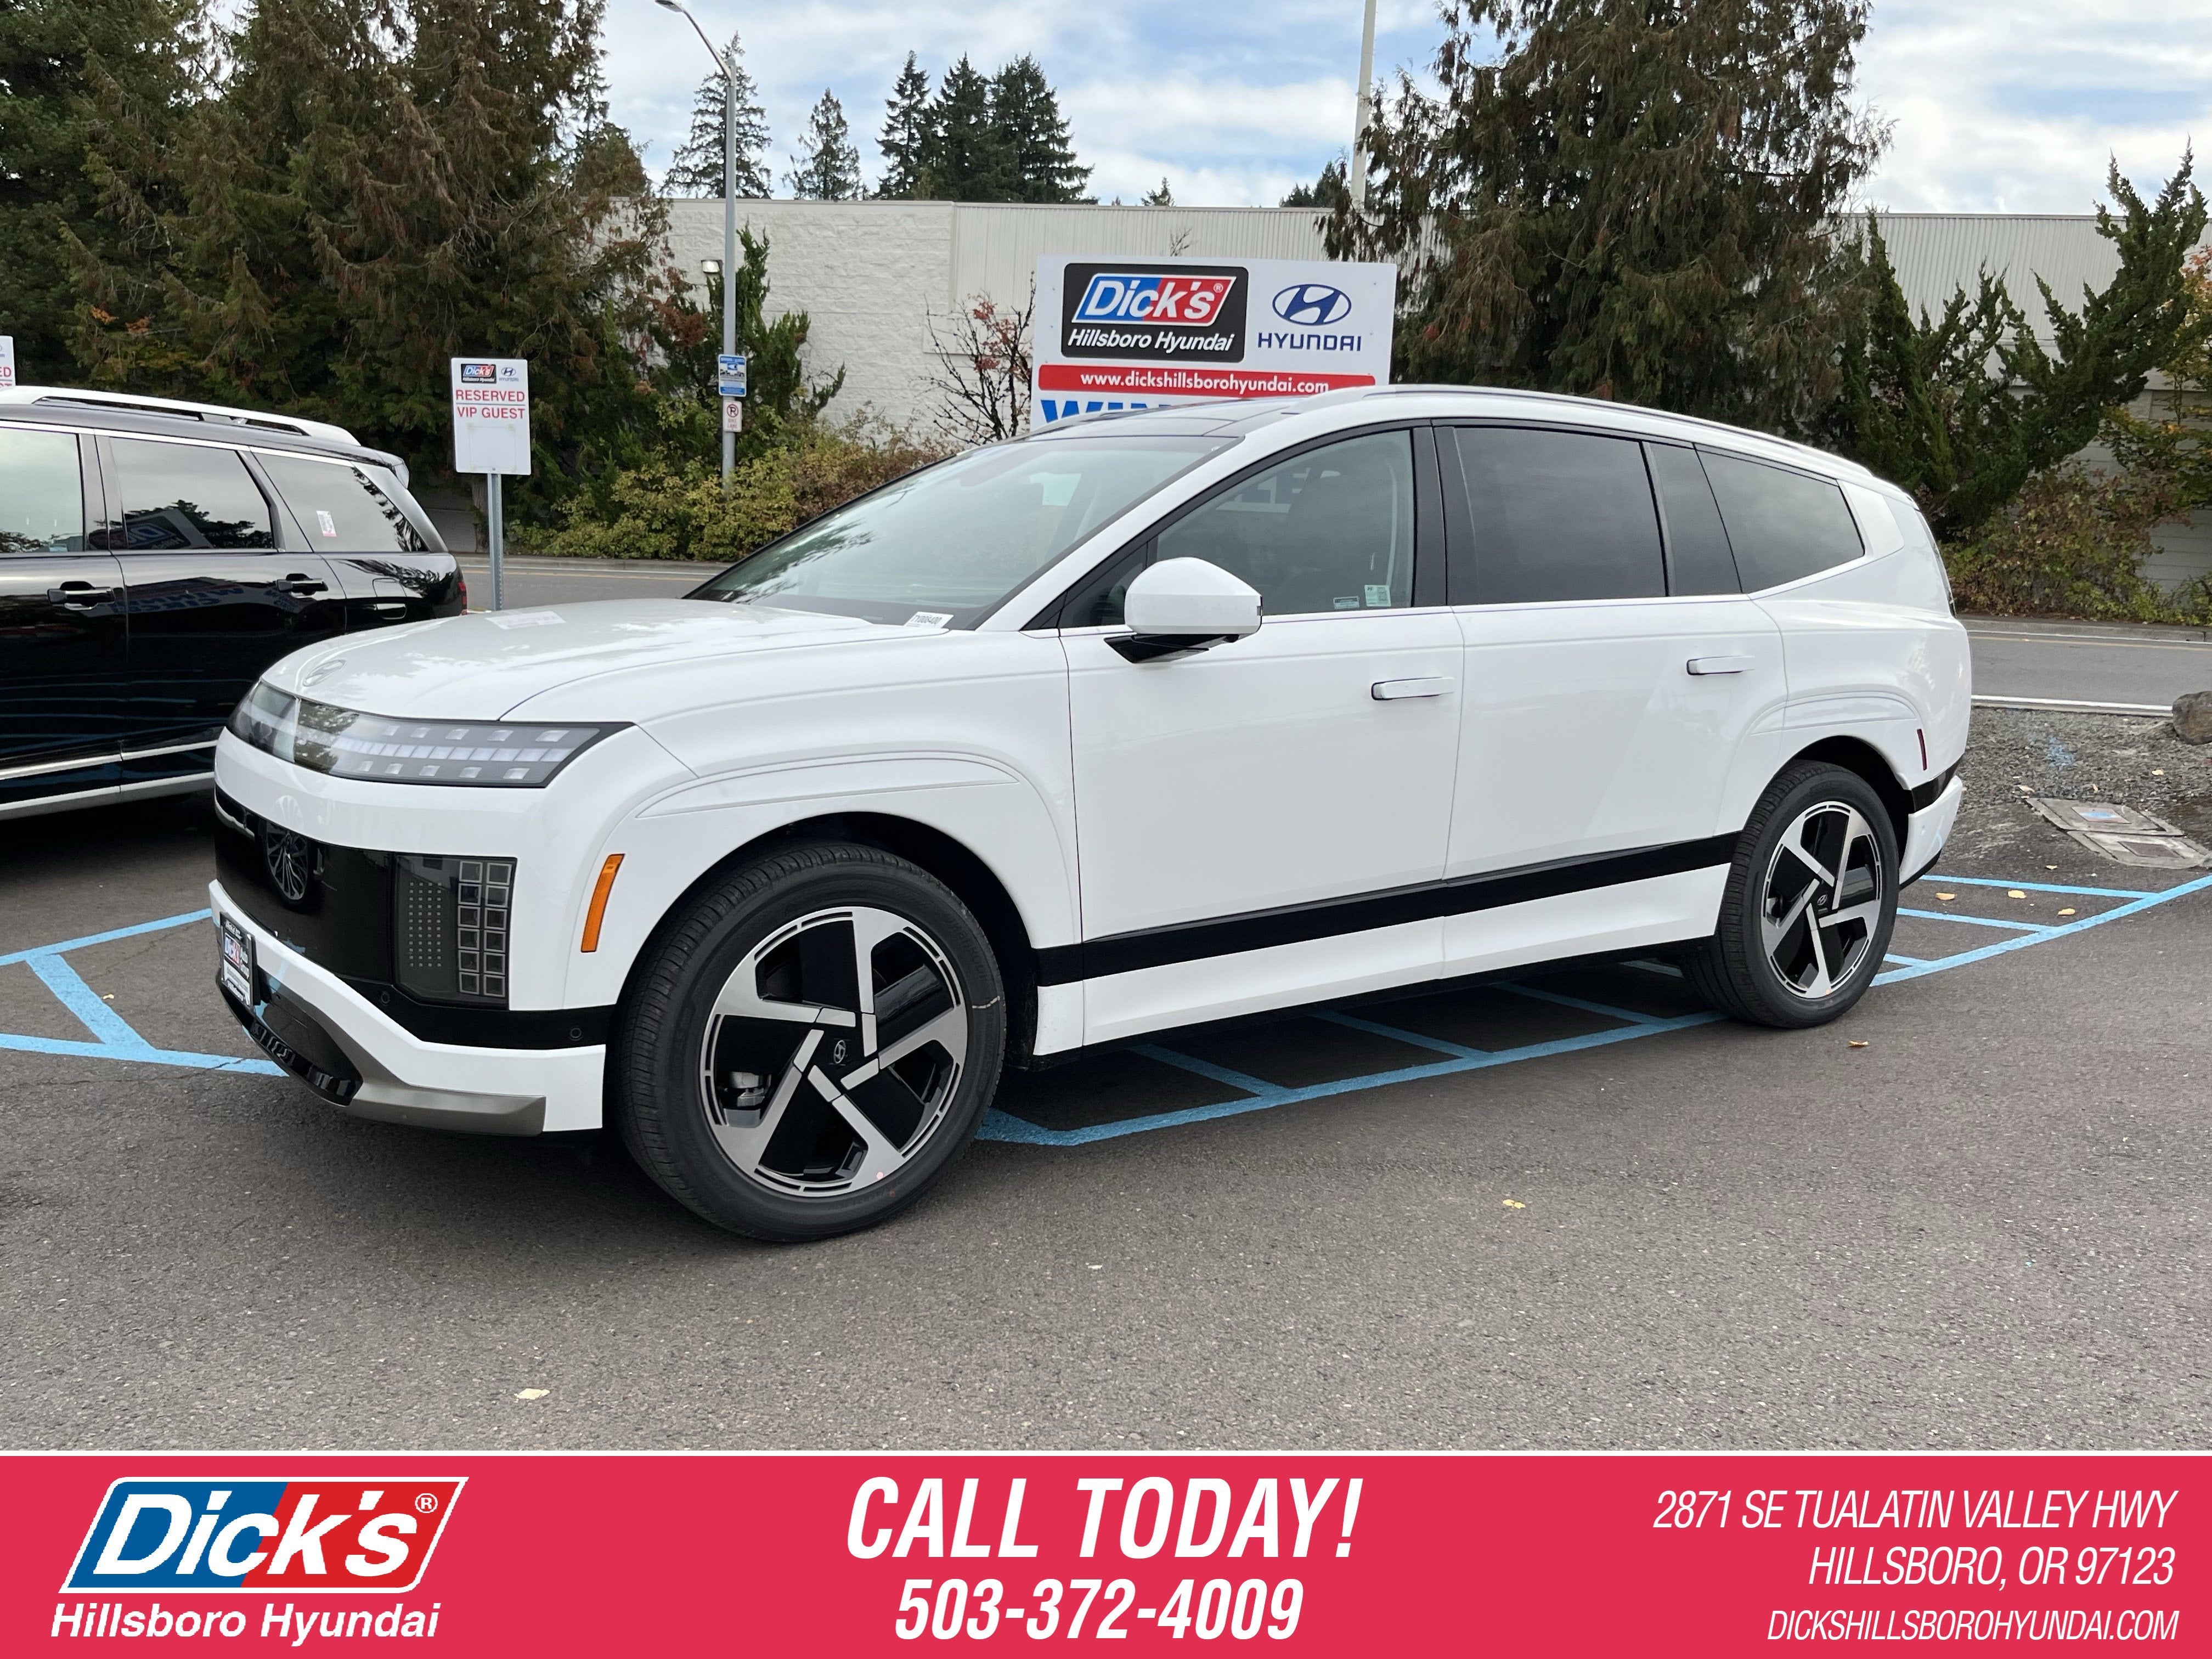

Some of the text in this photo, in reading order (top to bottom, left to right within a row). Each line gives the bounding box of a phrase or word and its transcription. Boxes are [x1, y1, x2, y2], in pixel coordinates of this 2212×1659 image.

[1068, 329, 1235, 353] Hillsboro Hyundai
[1257, 332, 1362, 352] HYUNDAI
[1080, 370, 1329, 394] www.dickshillsborohyundai.com
[456, 390, 525, 402] RESERVED
[457, 407, 526, 419] VIP GUEST
